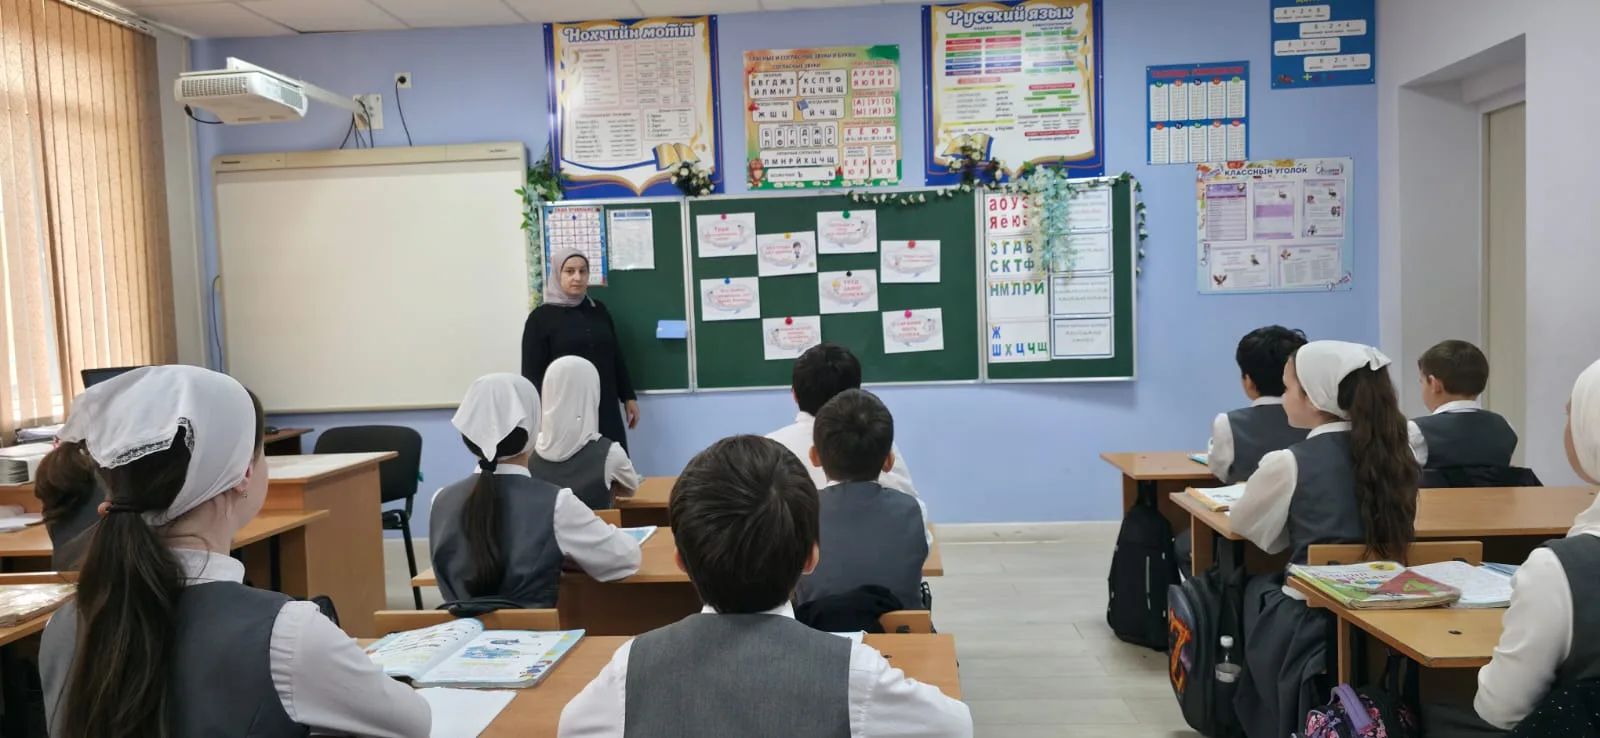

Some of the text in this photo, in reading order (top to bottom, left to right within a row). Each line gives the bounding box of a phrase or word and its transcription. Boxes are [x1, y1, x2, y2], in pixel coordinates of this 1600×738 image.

[946, 7, 1024, 28] Русский
[1027, 7, 1074, 20] язык
[563, 23, 695, 42] Нохчийн мотт
[990, 258, 1035, 272] С К Т Ф
[992, 326, 1001, 339] Ж
[992, 342, 1048, 356] Ш Х Ц Ч Щ
